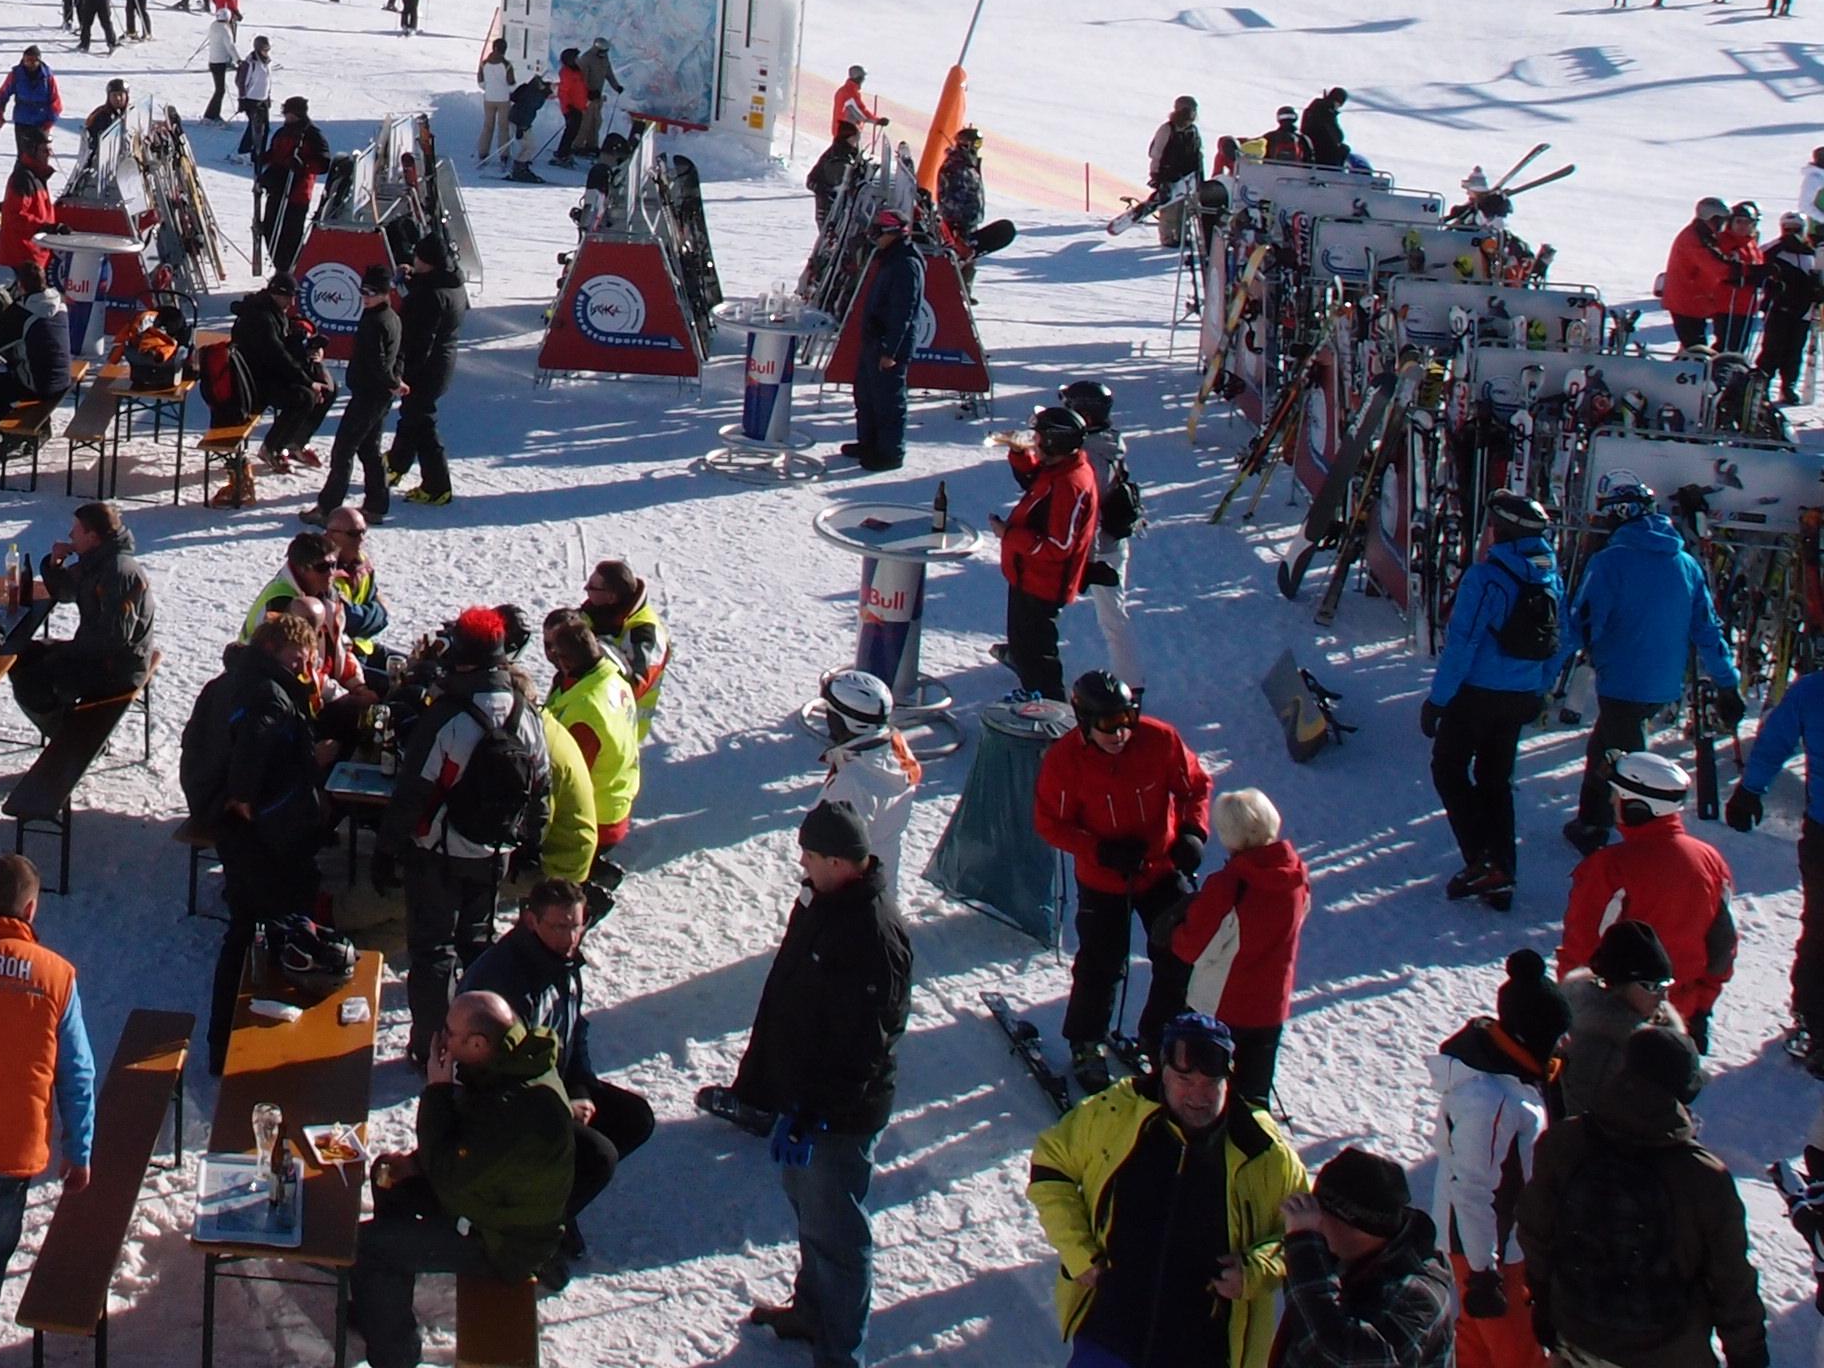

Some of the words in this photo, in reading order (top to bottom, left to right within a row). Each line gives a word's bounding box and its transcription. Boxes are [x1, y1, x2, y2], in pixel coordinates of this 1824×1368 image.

[1421, 203, 1437, 214] 16
[64, 280, 90, 293] Bull
[747, 358, 775, 375] Bull
[1676, 372, 1697, 386] 61
[868, 588, 905, 611] Bull
